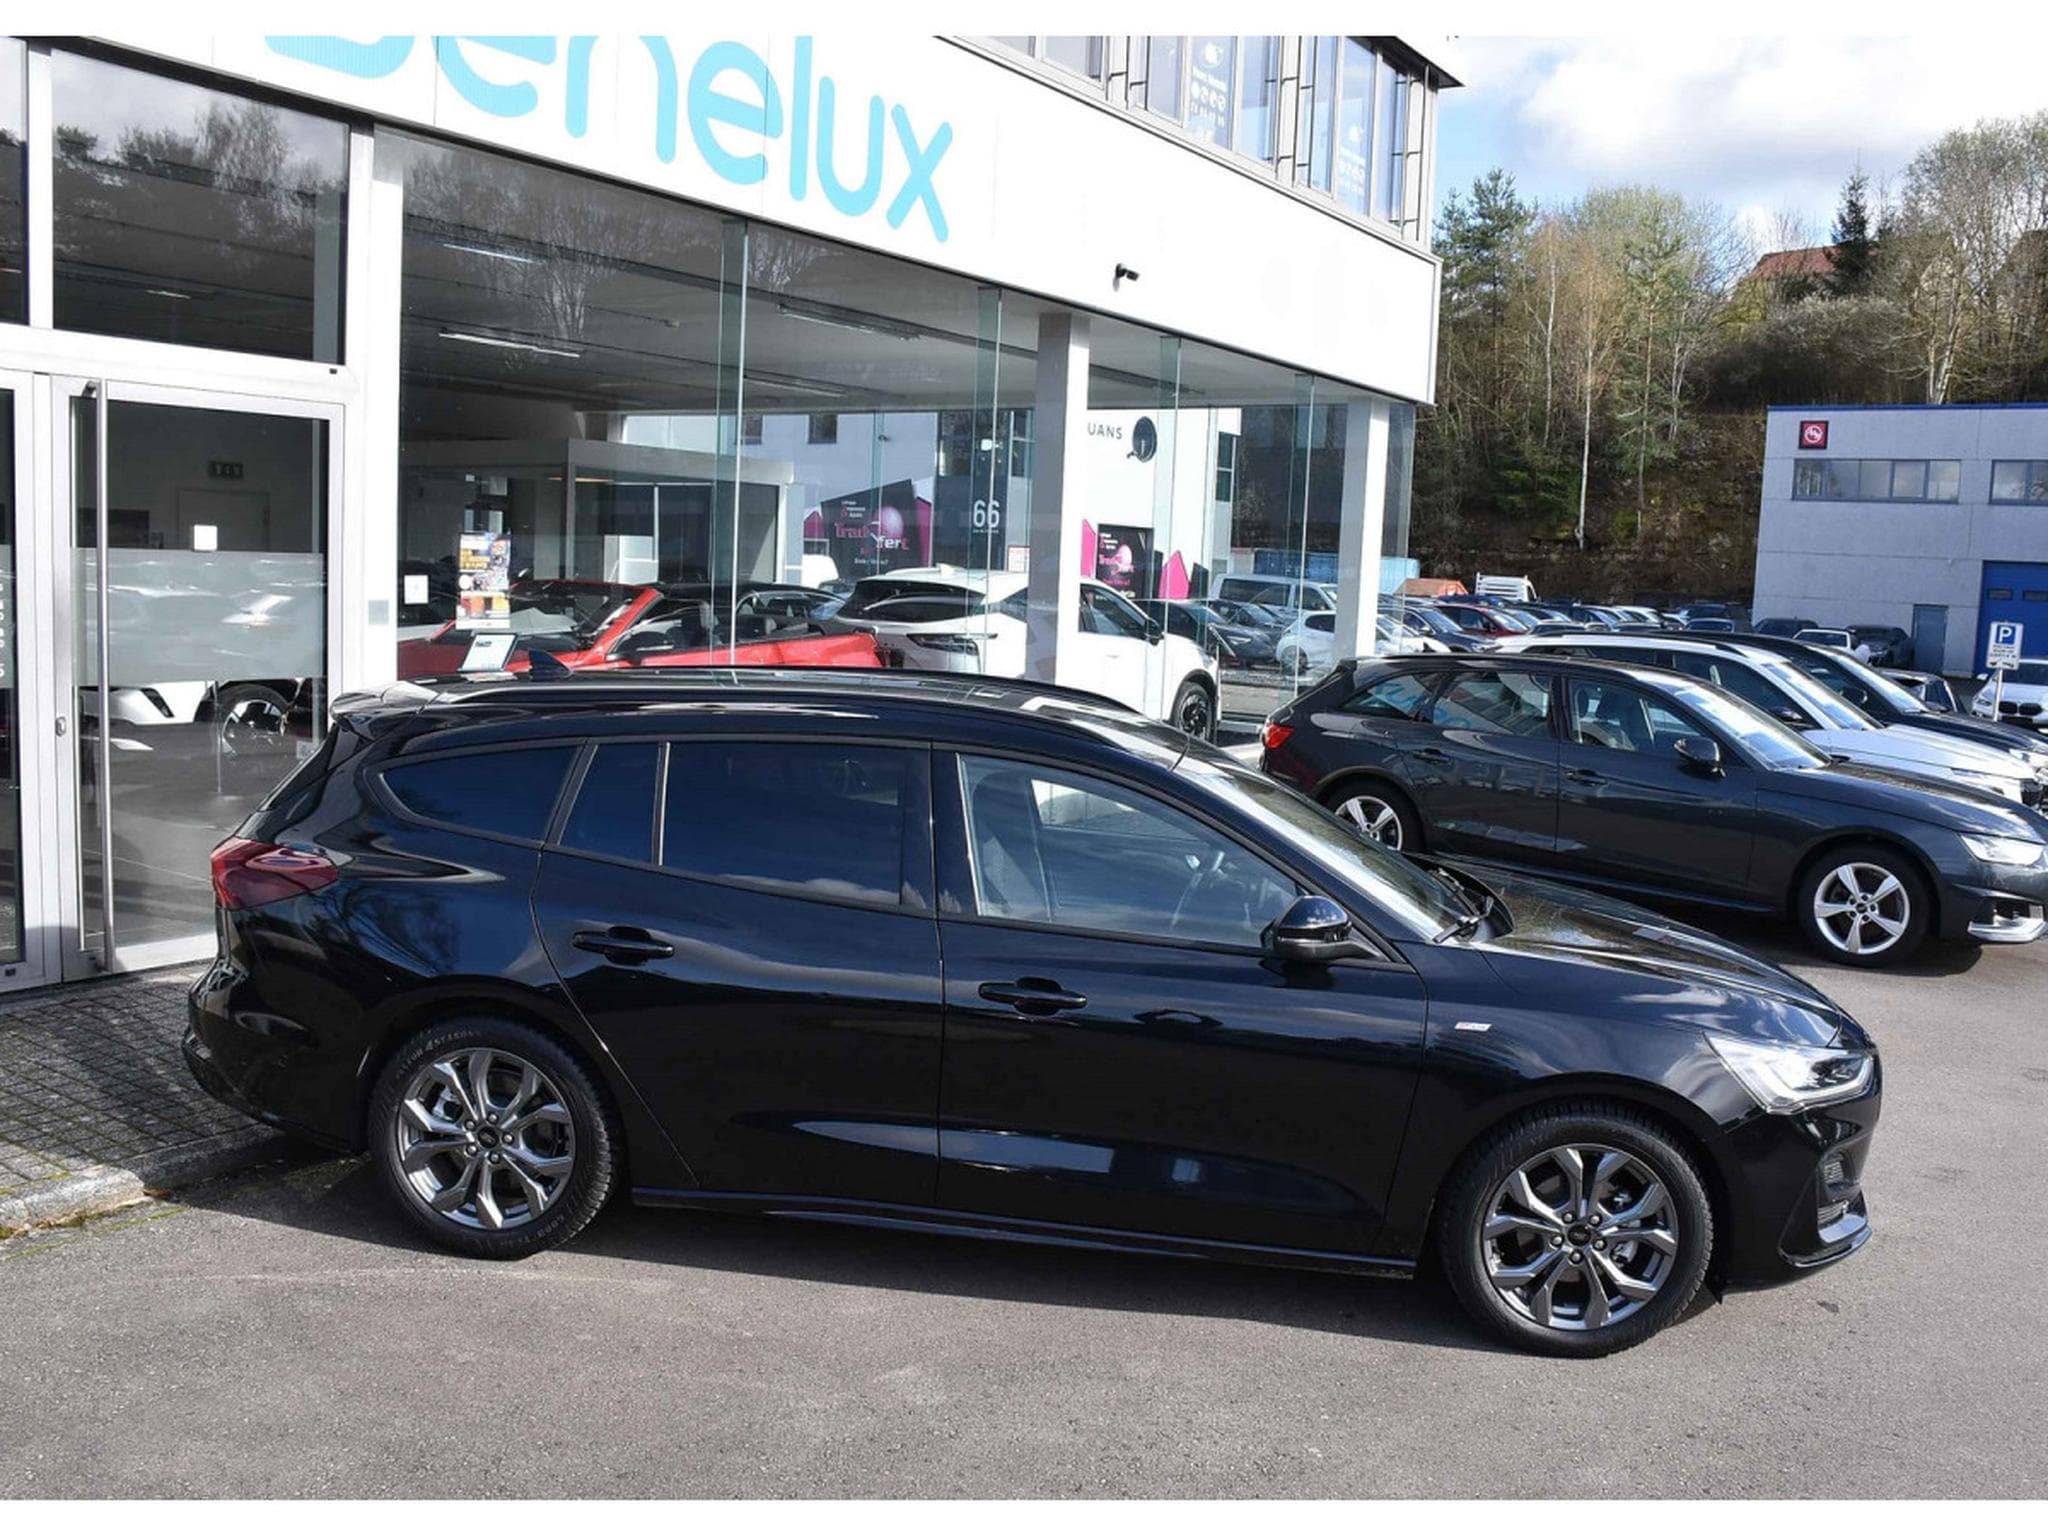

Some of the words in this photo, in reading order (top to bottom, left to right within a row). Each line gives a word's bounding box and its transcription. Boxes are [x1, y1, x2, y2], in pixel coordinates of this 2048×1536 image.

[265, 36, 954, 243] enelux
[973, 499, 1000, 529] 66
[1998, 626, 2013, 643] P
